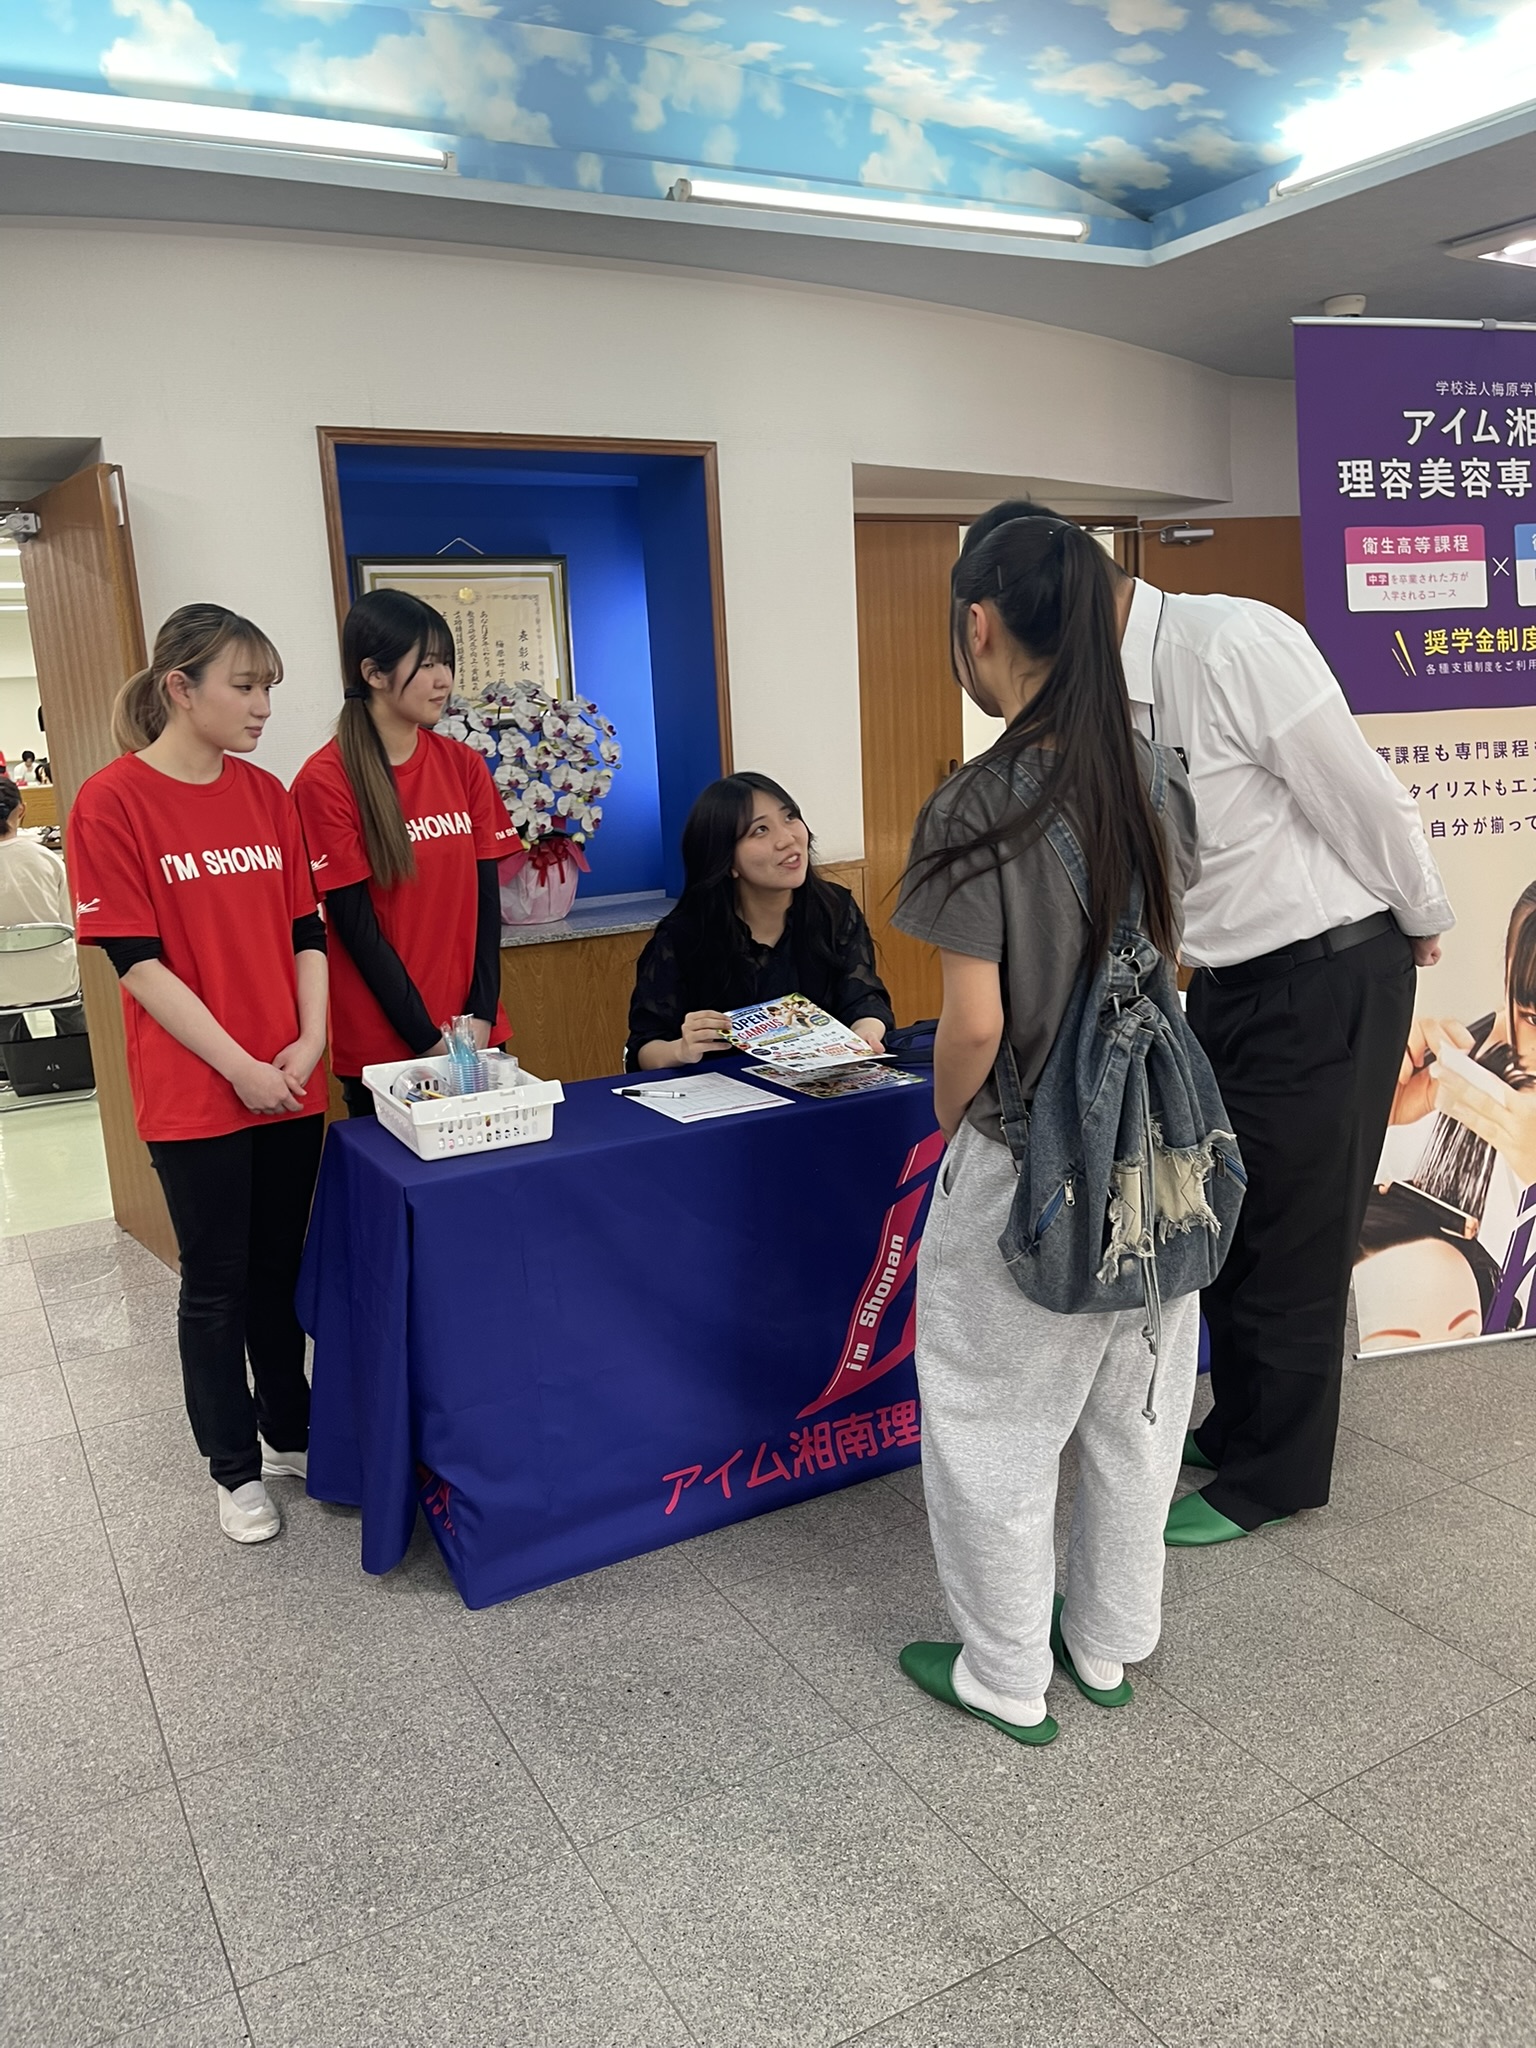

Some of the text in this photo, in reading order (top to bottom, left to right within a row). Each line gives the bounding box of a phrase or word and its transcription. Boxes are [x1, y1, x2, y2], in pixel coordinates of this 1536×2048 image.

[1435, 381, 1536, 397] 学校法人梅原学
[1402, 407, 1536, 447] アイム湘
[1338, 457, 1533, 499] 理容美容専
[1362, 535, 1470, 555] 衛生高等課程
[1382, 589, 1457, 601] 入学されるコース
[1424, 625, 1536, 656] 奨学金制度
[1375, 740, 1536, 765] 等課程も専門課程
[1409, 779, 1536, 800] タイリストもエ
[1423, 815, 1536, 838] 自分が揃って
[160, 852, 200, 884] I'M
[732, 1011, 770, 1031] OPEN
[737, 1018, 785, 1040] CAMPUS
[858, 1233, 905, 1329] Shonan
